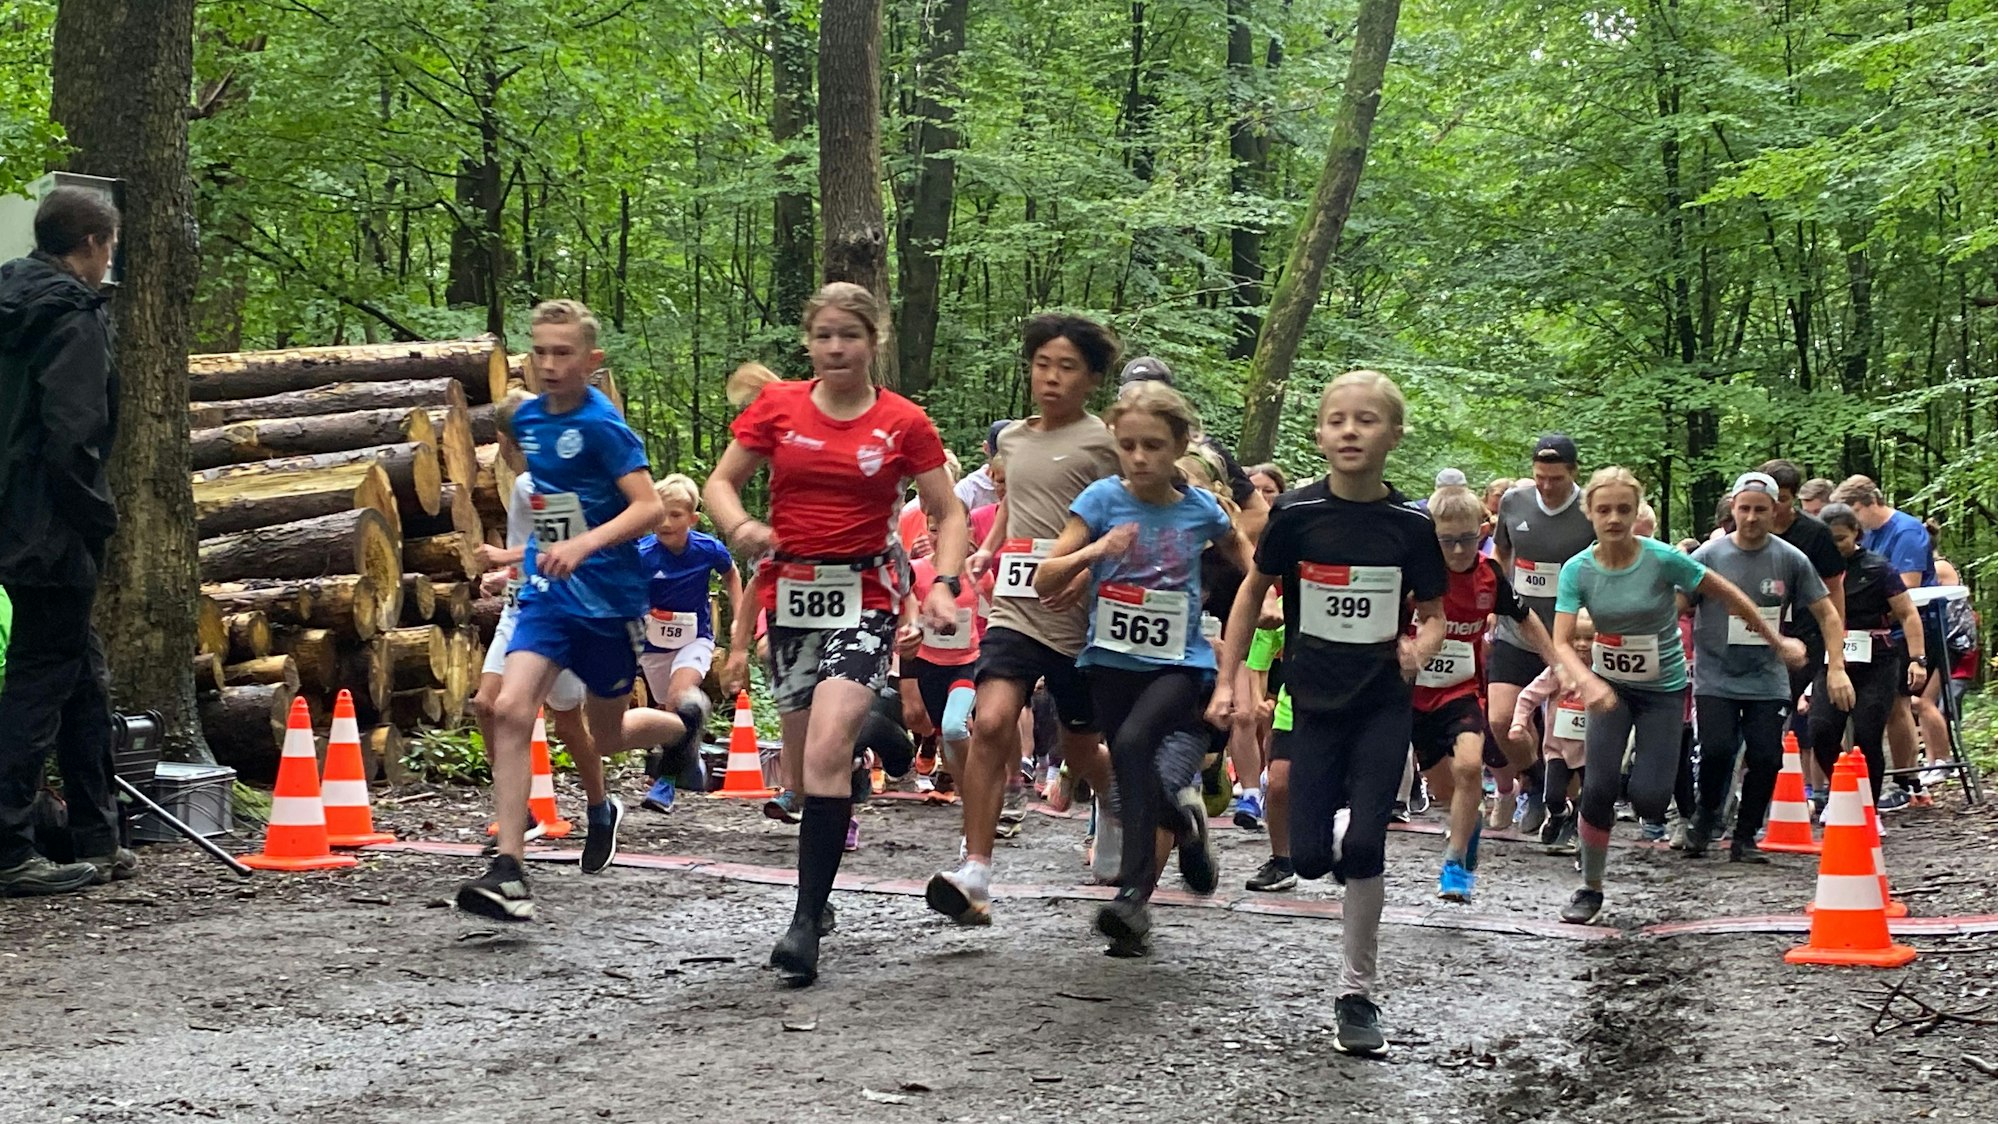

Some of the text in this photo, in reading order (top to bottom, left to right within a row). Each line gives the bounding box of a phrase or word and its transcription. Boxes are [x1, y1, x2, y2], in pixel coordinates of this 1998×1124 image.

[1008, 562, 1038, 587] 57
[1526, 576, 1546, 586] 400
[789, 590, 845, 617] 588
[1326, 596, 1370, 618] 399
[660, 626, 682, 637] 158
[1110, 611, 1169, 647] 563
[1424, 657, 1454, 673] 282
[1602, 652, 1646, 673] 562
[1572, 716, 1585, 727] 43
